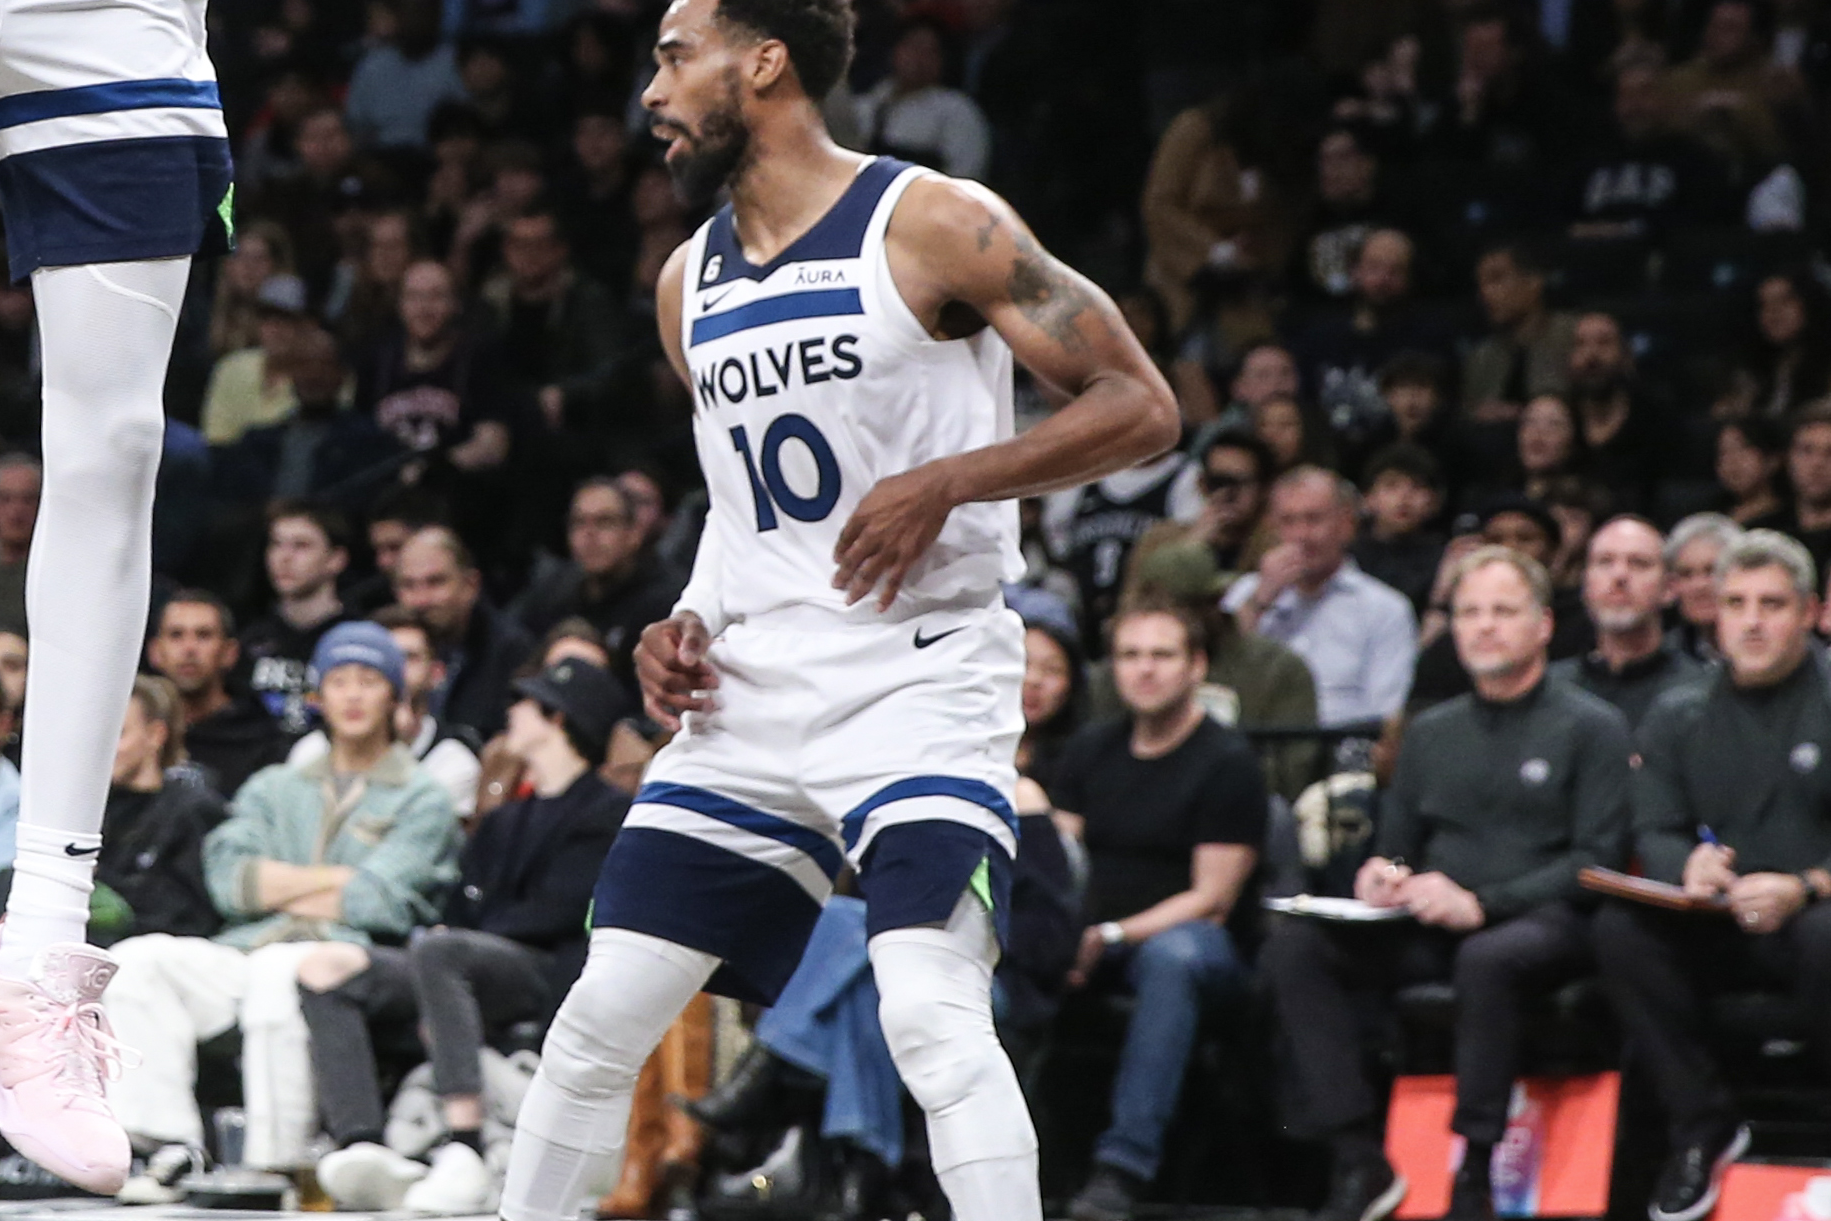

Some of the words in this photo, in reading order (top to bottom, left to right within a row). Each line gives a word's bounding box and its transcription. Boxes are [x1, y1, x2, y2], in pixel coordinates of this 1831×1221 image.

[702, 254, 721, 282] 6
[694, 334, 862, 410] WOLVES
[729, 413, 842, 533] 10
